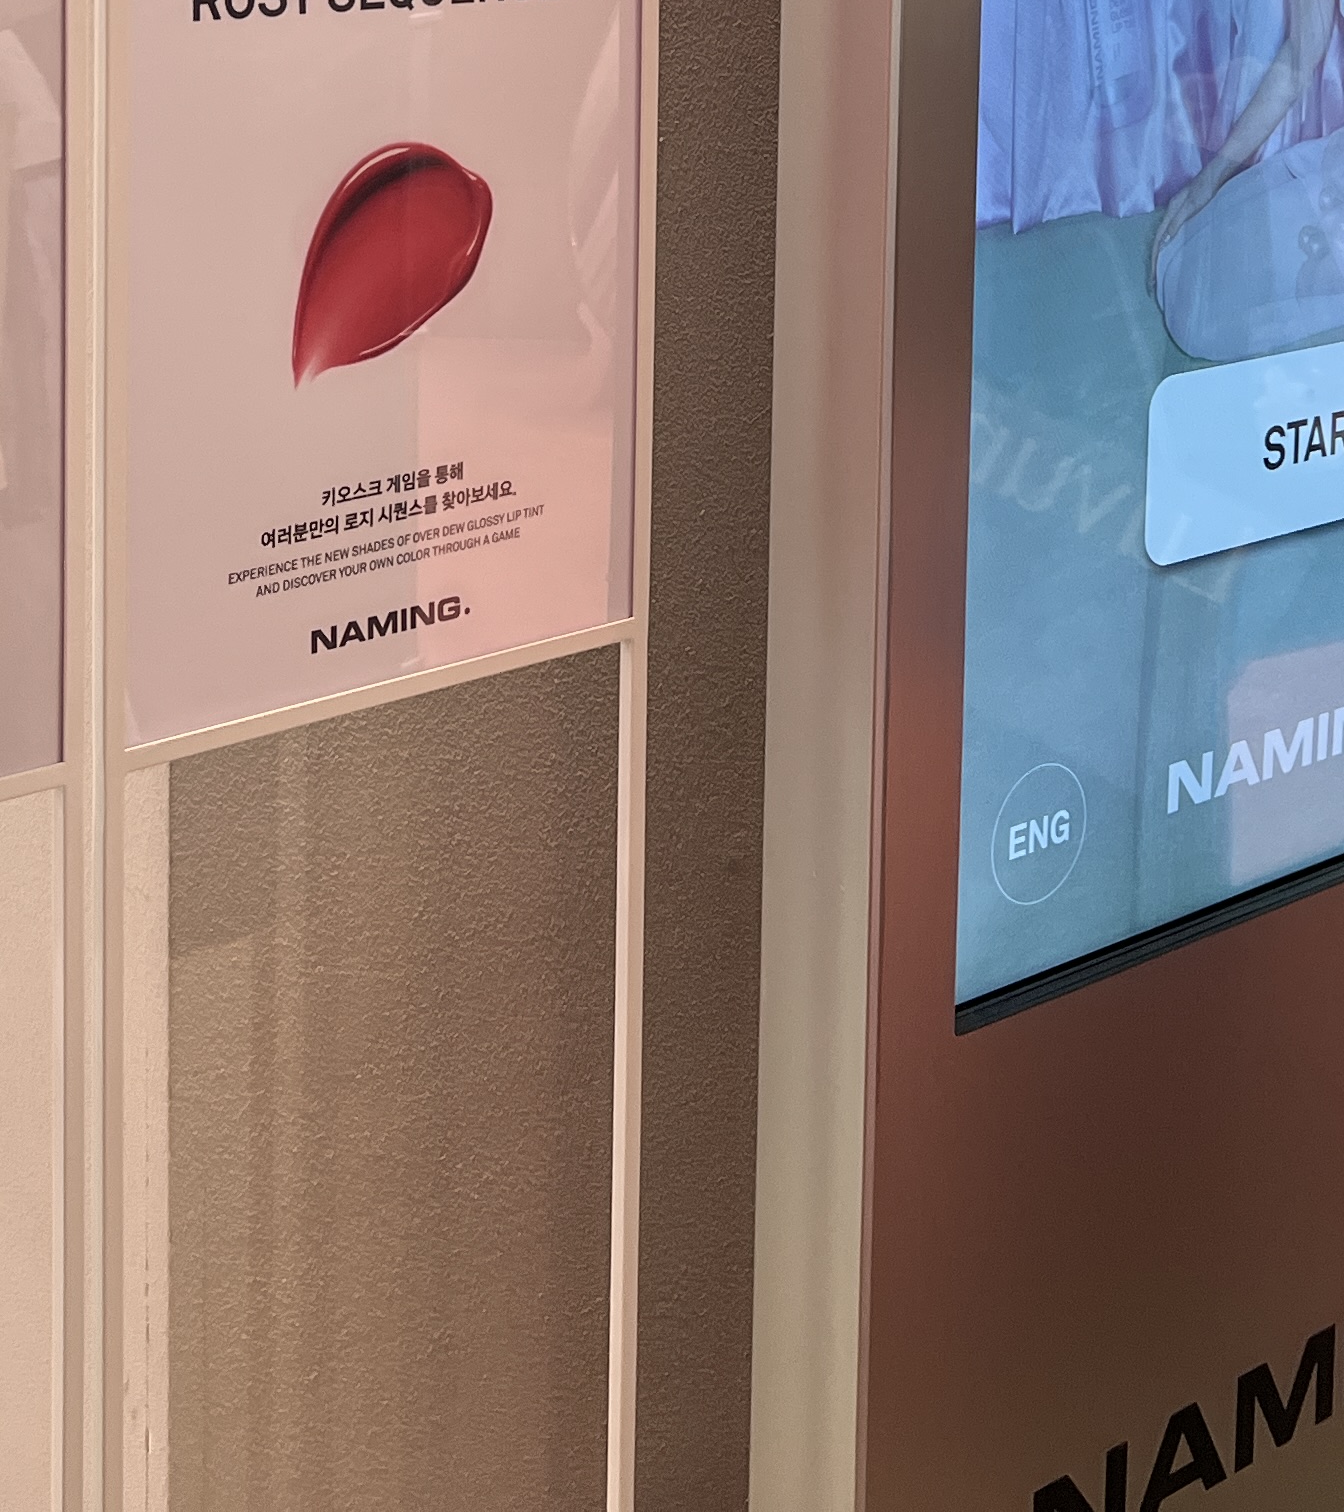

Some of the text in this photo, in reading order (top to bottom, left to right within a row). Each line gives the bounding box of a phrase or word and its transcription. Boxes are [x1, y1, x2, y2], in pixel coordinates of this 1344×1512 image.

[321, 461, 464, 507] 키오스크 게임을 통해
[228, 504, 545, 585] EXPERIENCE THE NEW SHADES OF OVER DEW GLOSSY LIP TINT
[255, 526, 520, 598] AND DISCOVER YOUR OWN COLOR THROUGH A GAME
[311, 595, 471, 655] NAMING.
[1007, 810, 1071, 861] ENG
